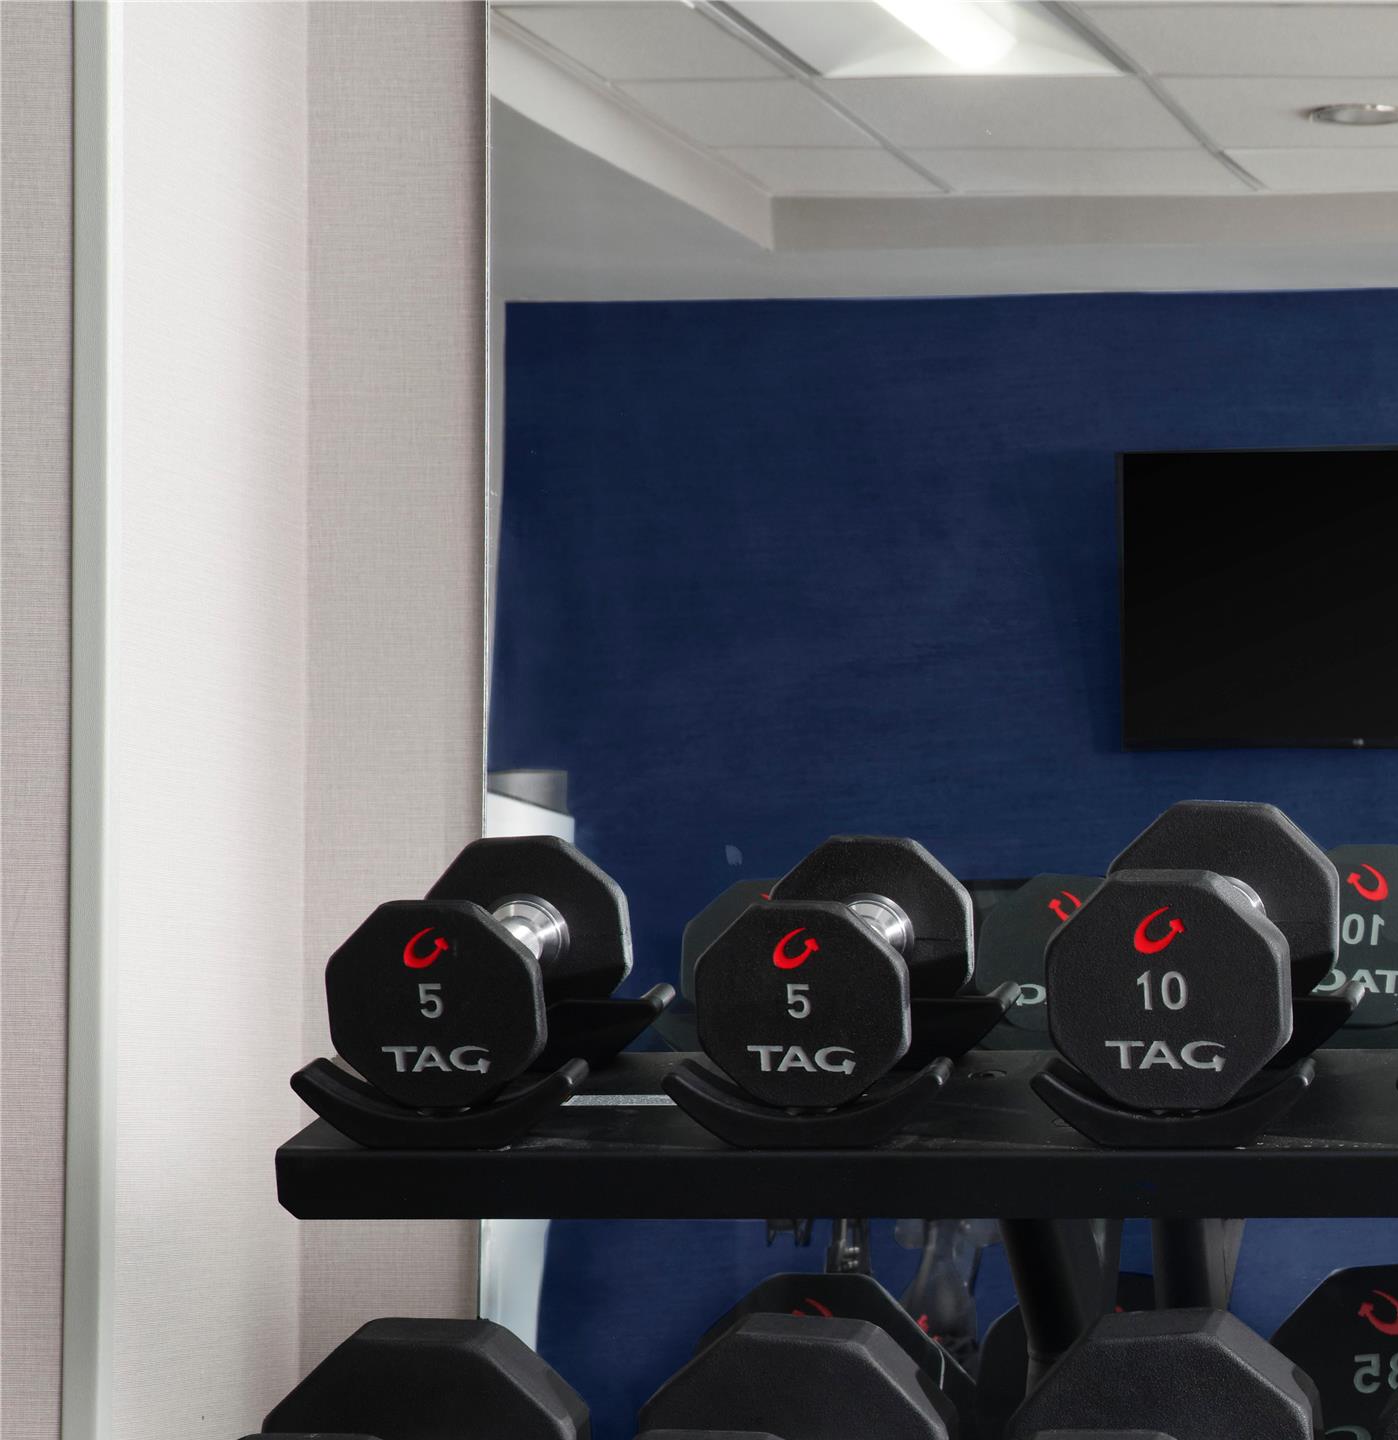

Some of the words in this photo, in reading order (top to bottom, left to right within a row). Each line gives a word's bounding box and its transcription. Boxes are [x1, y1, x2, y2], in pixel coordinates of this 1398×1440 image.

[417, 982, 444, 1020] 5
[785, 982, 812, 1020] 5
[1135, 969, 1189, 1012] 10
[380, 1044, 491, 1075] TAG
[745, 1043, 857, 1076] TAG
[1103, 1039, 1225, 1074] TAG
